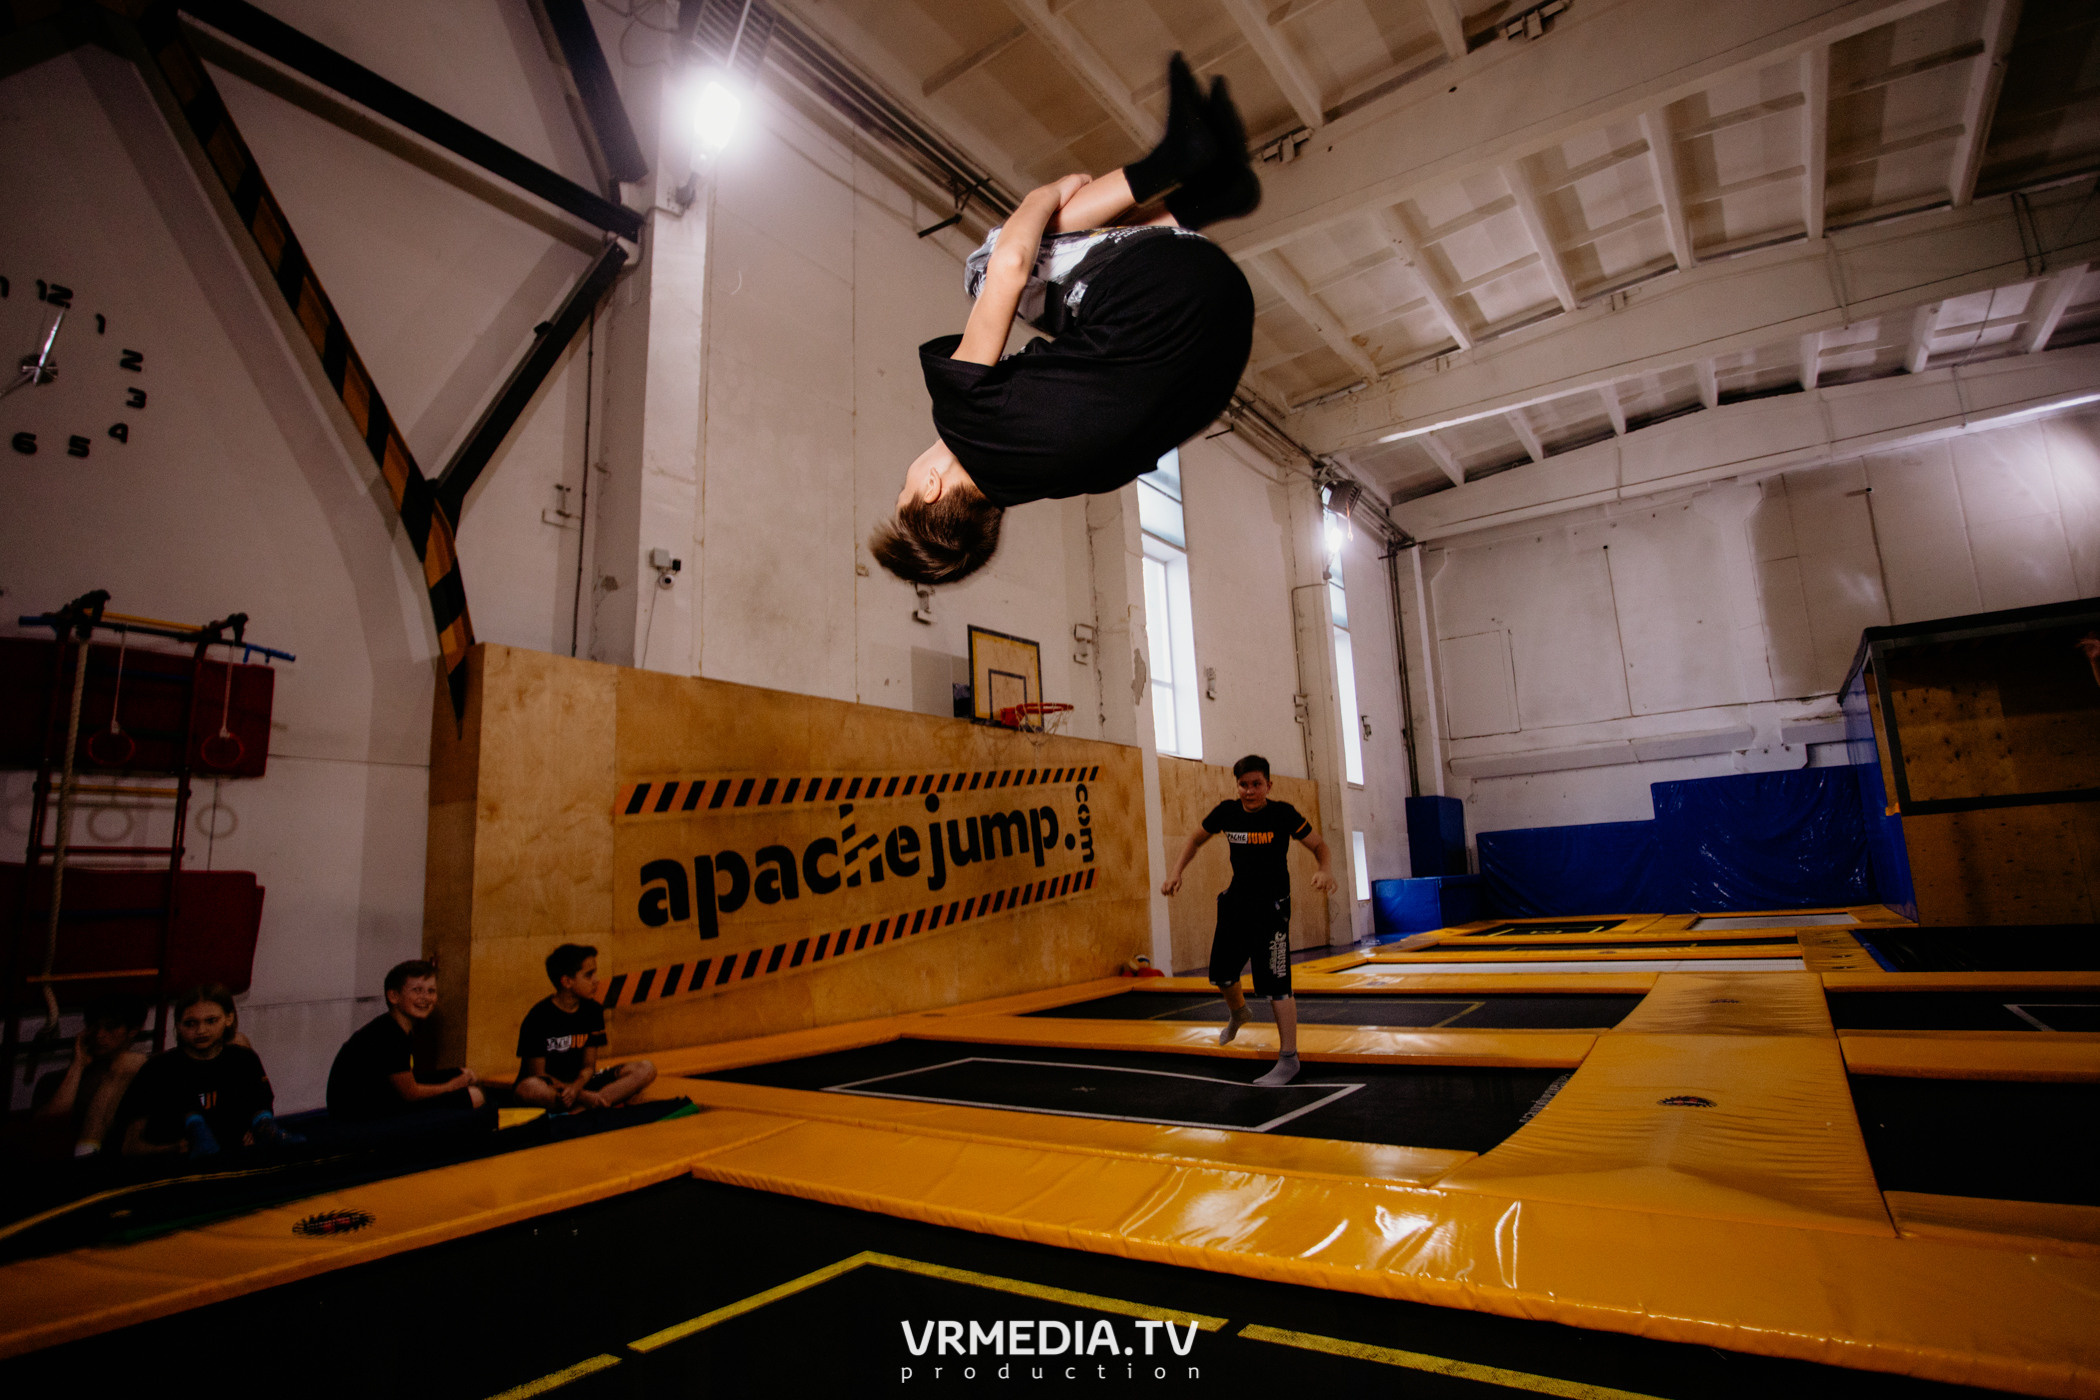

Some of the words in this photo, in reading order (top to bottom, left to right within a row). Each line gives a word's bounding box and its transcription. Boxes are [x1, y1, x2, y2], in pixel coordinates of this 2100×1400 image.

[36, 279, 74, 309] 12
[95, 313, 106, 335] 1
[120, 349, 144, 372] 2
[126, 387, 147, 409] 3
[12, 432, 38, 455] 6
[108, 422, 129, 444] 4
[67, 434, 91, 459] 5
